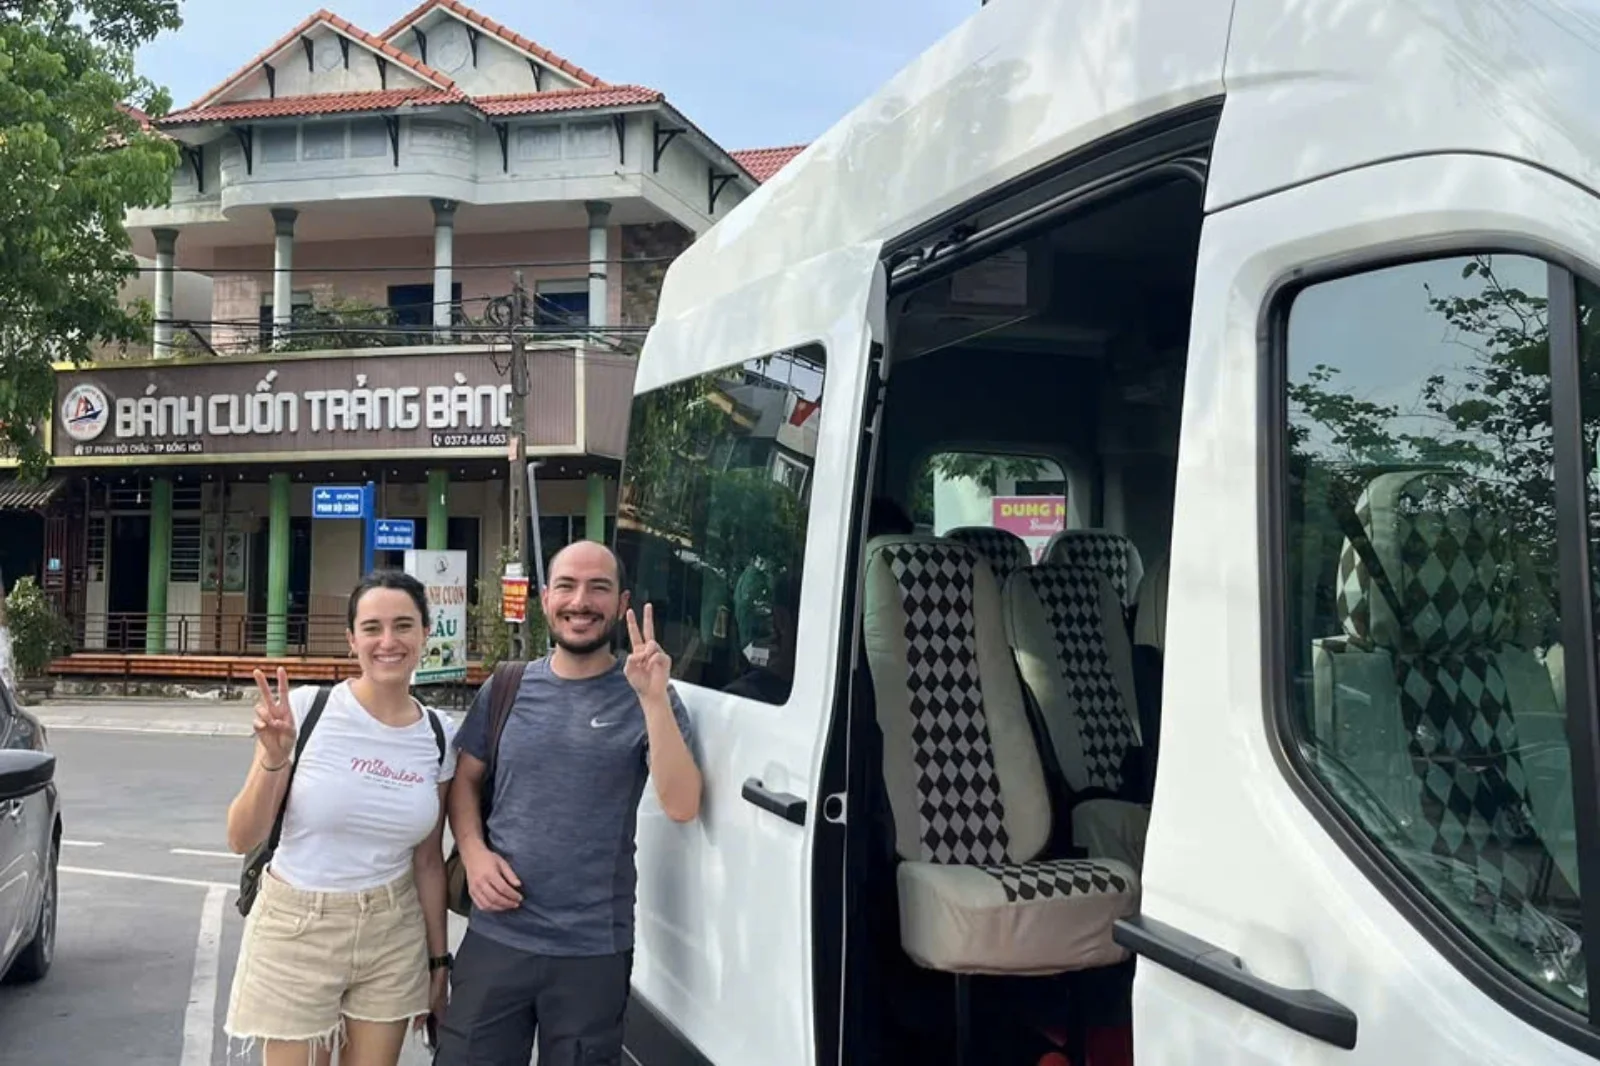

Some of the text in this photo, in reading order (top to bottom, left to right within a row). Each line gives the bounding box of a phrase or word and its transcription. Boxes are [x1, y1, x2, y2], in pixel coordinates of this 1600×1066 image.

[116, 384, 203, 437] BÁNH
[208, 369, 298, 435] CUỐN
[304, 374, 420, 432] TRẢNG
[445, 433, 506, 445] 0373 484 053
